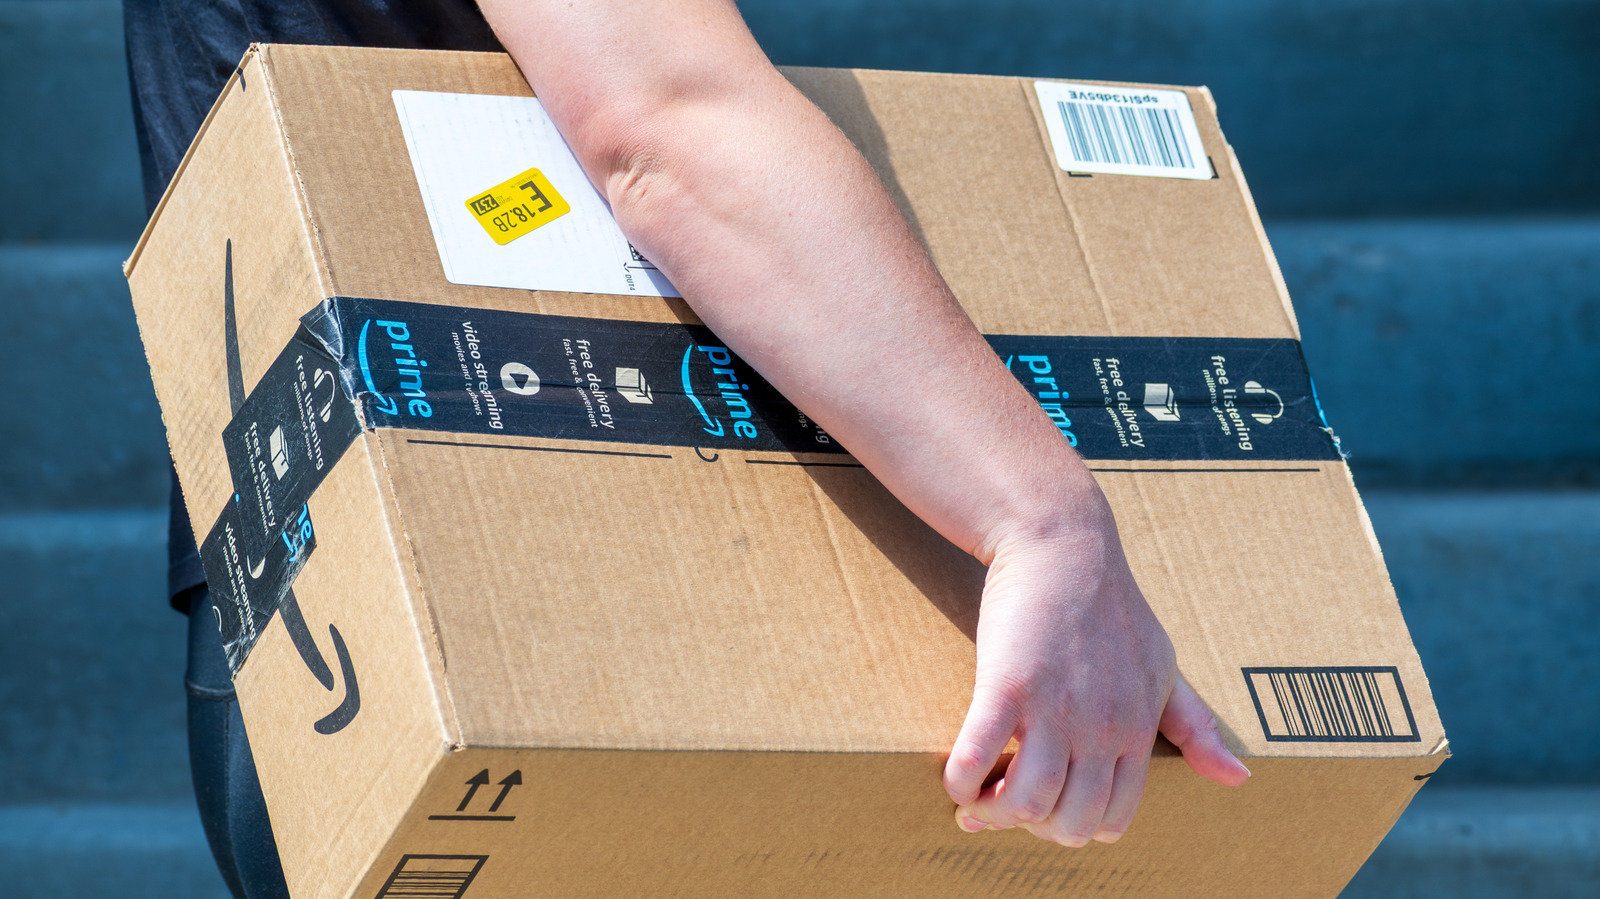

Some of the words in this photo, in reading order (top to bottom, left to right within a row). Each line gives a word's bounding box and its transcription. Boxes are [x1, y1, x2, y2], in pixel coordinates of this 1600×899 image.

[473, 196, 498, 215] 237
[492, 203, 536, 232] 18.2B
[519, 180, 553, 213] E
[376, 319, 433, 418] prime
[452, 332, 466, 363] movies
[460, 363, 473, 381] and
[462, 321, 482, 360] video
[473, 362, 504, 430] streaming
[562, 338, 573, 356] fast,
[568, 358, 579, 376] free
[577, 386, 599, 428] convenient
[576, 338, 594, 369] free
[586, 373, 615, 429] delivery
[1092, 358, 1104, 376] fast,
[1099, 377, 1110, 395] free
[1203, 369, 1217, 404] millions
[293, 381, 305, 420] millions
[302, 421, 308, 431] of
[305, 432, 313, 460] songs
[296, 354, 307, 392] free
[305, 391, 324, 471] listening
[698, 345, 758, 439] prime
[1104, 397, 1112, 405] &
[1106, 357, 1124, 387] free
[1116, 391, 1145, 448] delivery
[1211, 355, 1229, 385] free
[1223, 388, 1253, 450] listening
[1212, 406, 1223, 414] of
[1216, 413, 1231, 436] songs
[1106, 407, 1129, 447] convenient
[250, 421, 261, 458] free
[258, 460, 276, 527] delivery
[255, 485, 269, 536] convenient
[222, 546, 233, 578] movies
[230, 578, 238, 596] and
[238, 606, 247, 635] shows
[225, 522, 239, 564] video
[236, 564, 256, 640] streaming
